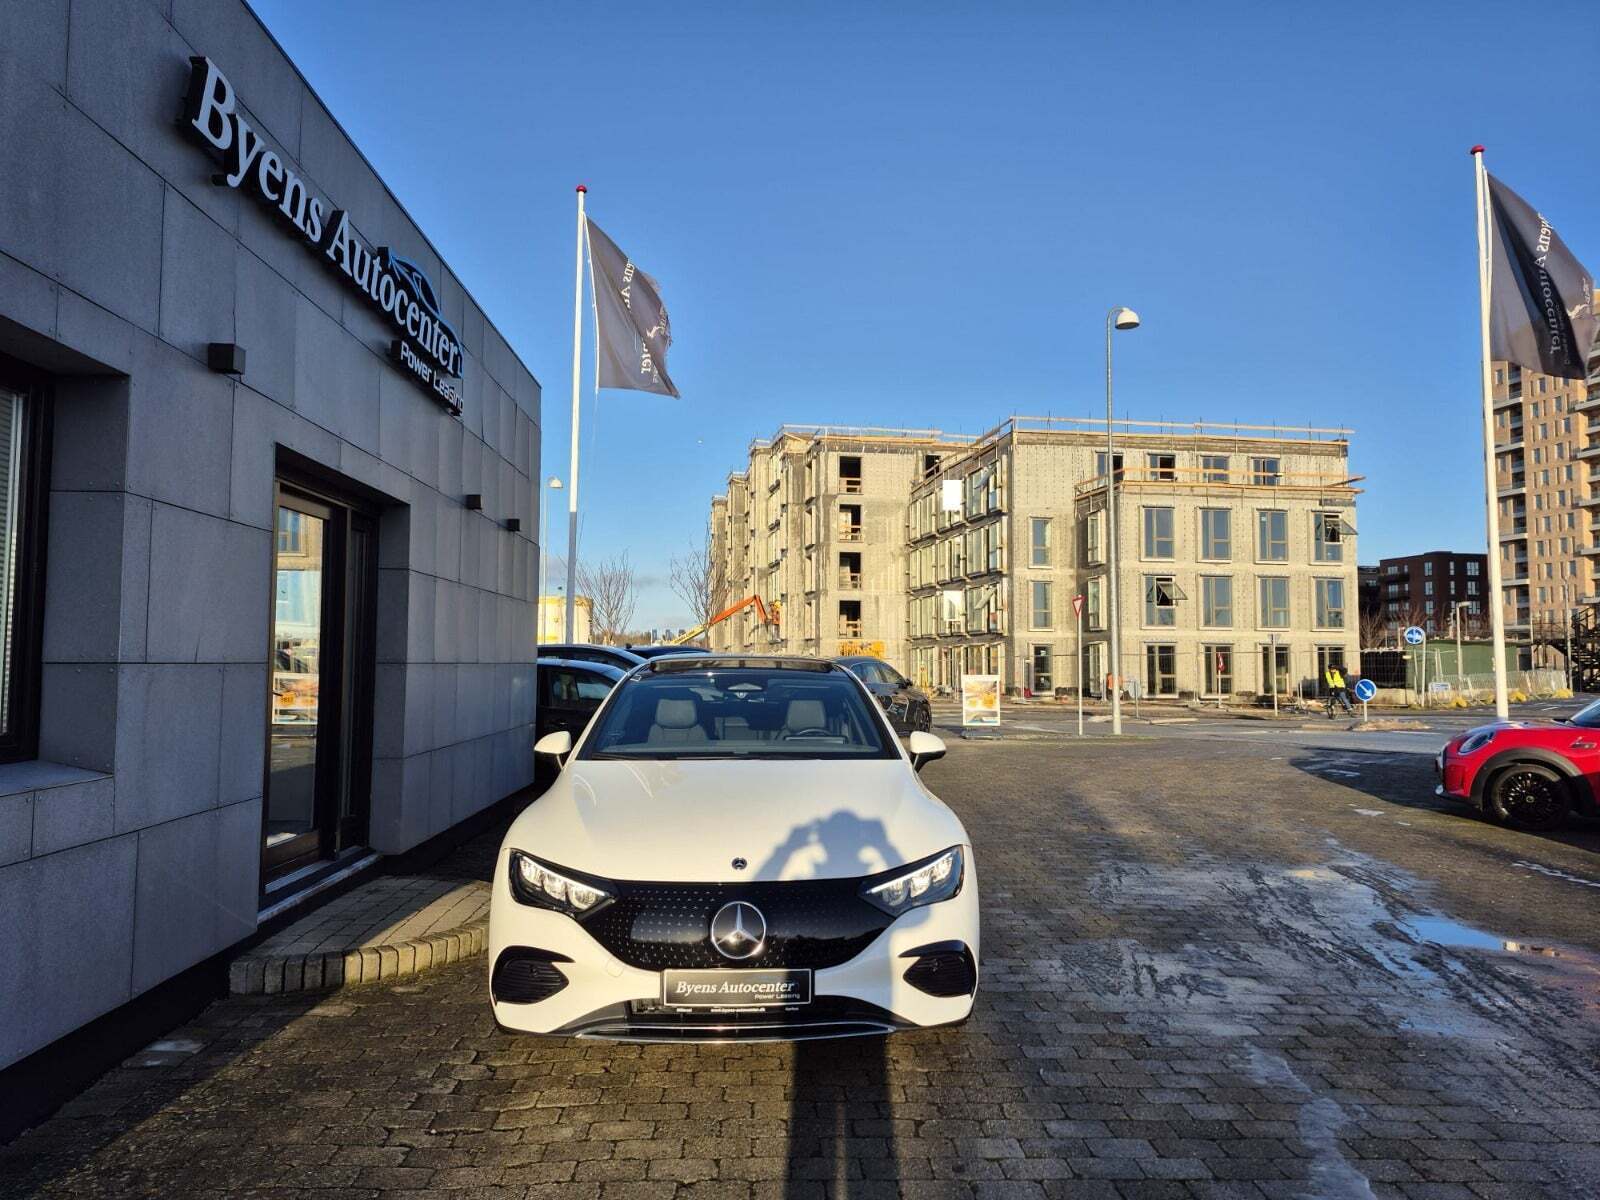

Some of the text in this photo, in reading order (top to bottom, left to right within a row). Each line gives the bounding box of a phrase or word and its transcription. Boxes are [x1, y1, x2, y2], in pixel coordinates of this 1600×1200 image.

[191, 56, 458, 375] Byens Autocenter
[400, 341, 464, 416] Power Leasing
[676, 981, 795, 996] Byens Autocenter
